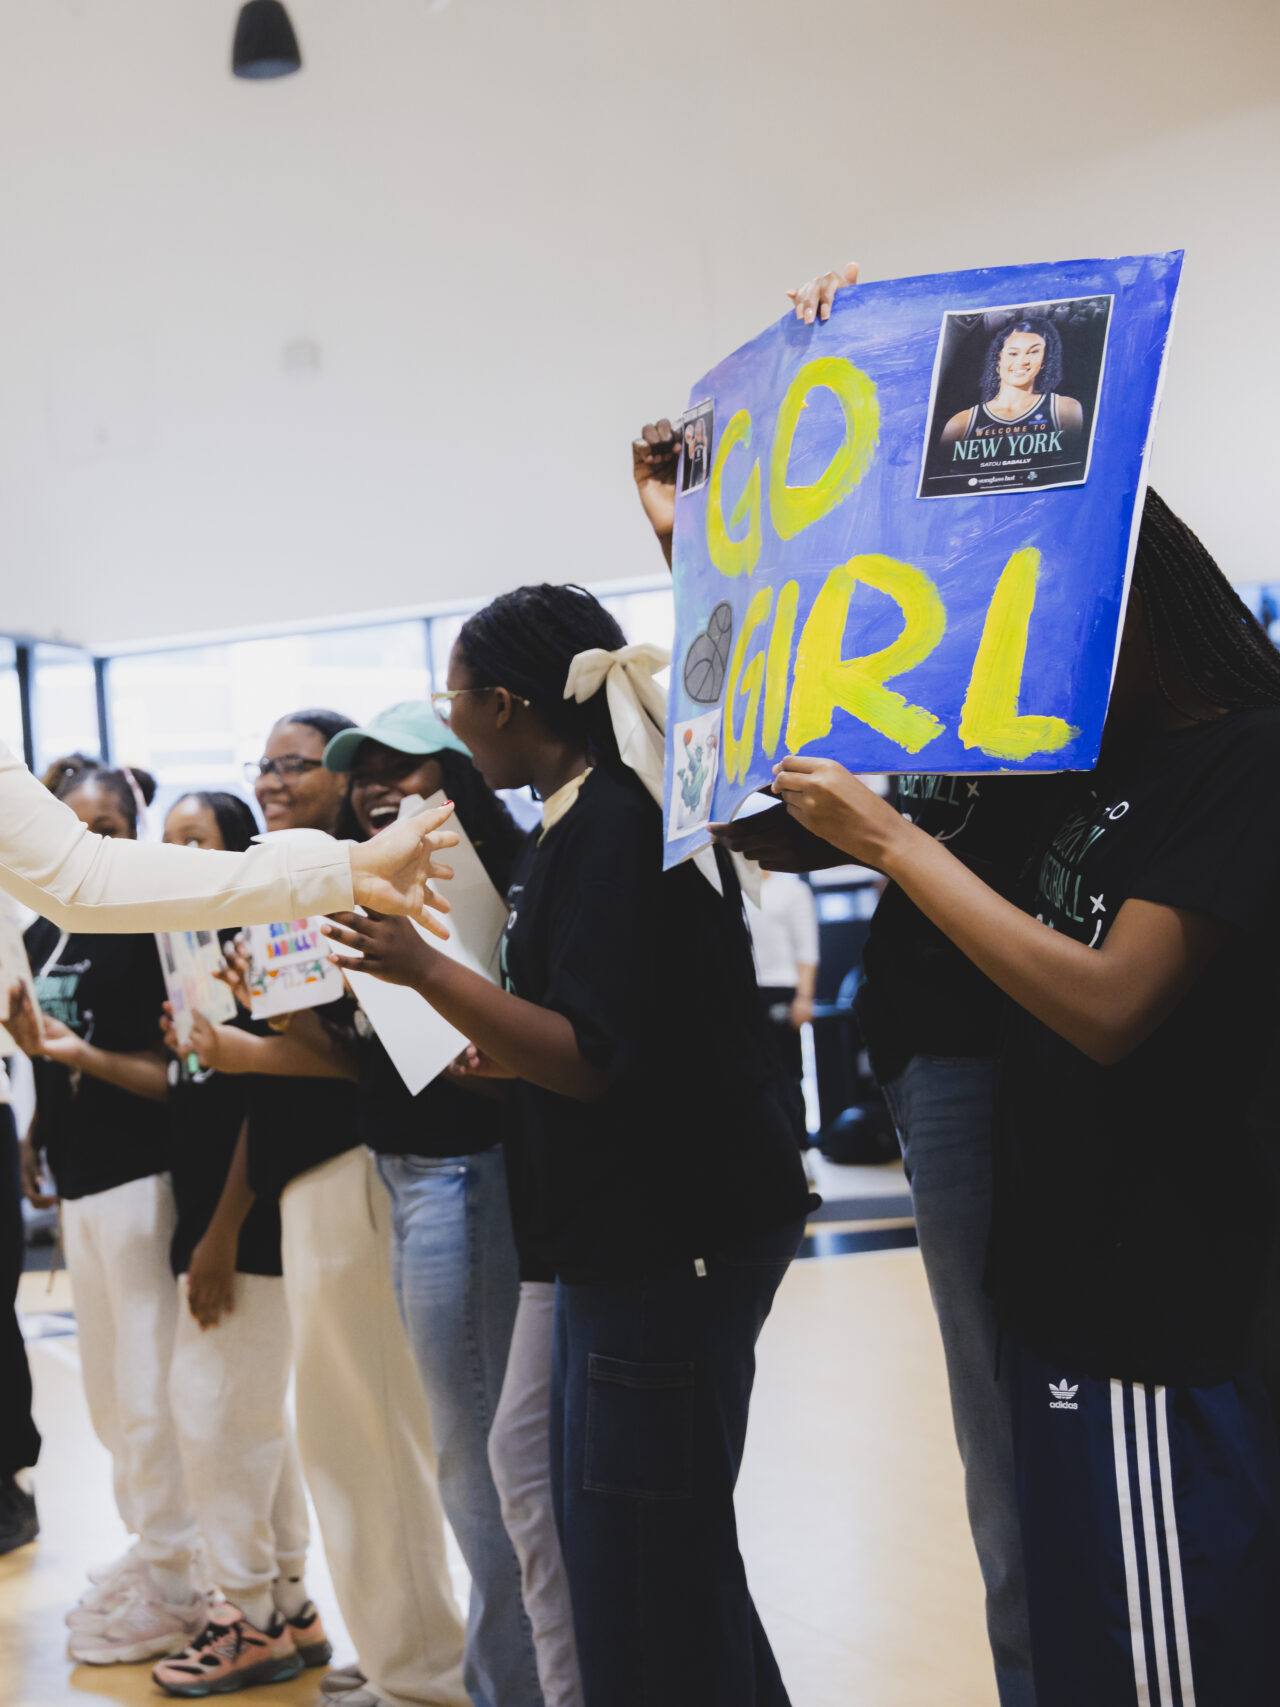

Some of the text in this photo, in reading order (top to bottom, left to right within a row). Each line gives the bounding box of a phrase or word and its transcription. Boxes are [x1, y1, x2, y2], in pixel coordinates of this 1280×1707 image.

[976, 425, 1027, 437] WELCOME
[952, 430, 1064, 461] NEW YORK
[705, 355, 880, 578] GO
[1002, 458, 1032, 466] SABALLY
[723, 546, 1081, 785] GIRL
[1049, 1400, 1079, 1410] adidas
